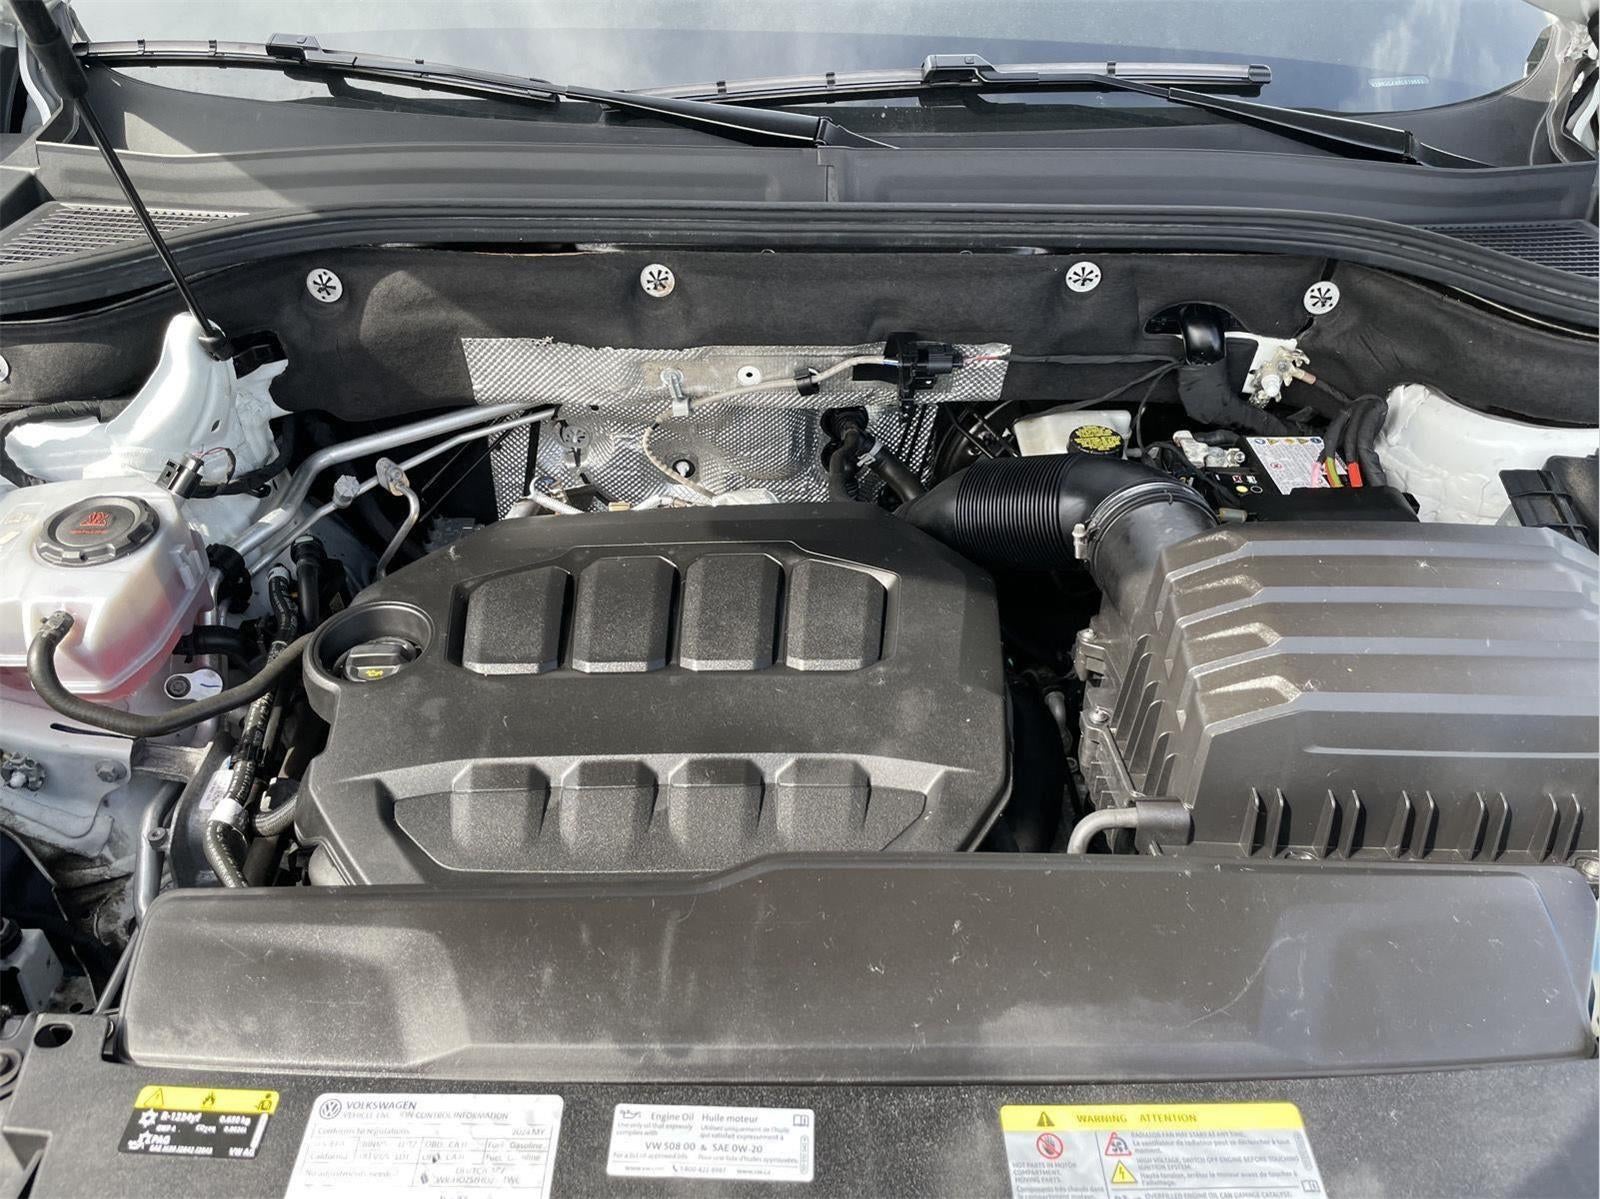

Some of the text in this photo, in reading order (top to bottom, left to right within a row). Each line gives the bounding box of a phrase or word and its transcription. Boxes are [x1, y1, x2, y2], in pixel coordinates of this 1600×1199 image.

[346, 1101, 417, 1110] VOLKSWAGEN
[651, 1112, 694, 1122] Engine Oil
[1077, 1114, 1197, 1123] WARNING ATTENTION
[229, 1147, 255, 1156] VW AG
[713, 1144, 729, 1152] SAE
